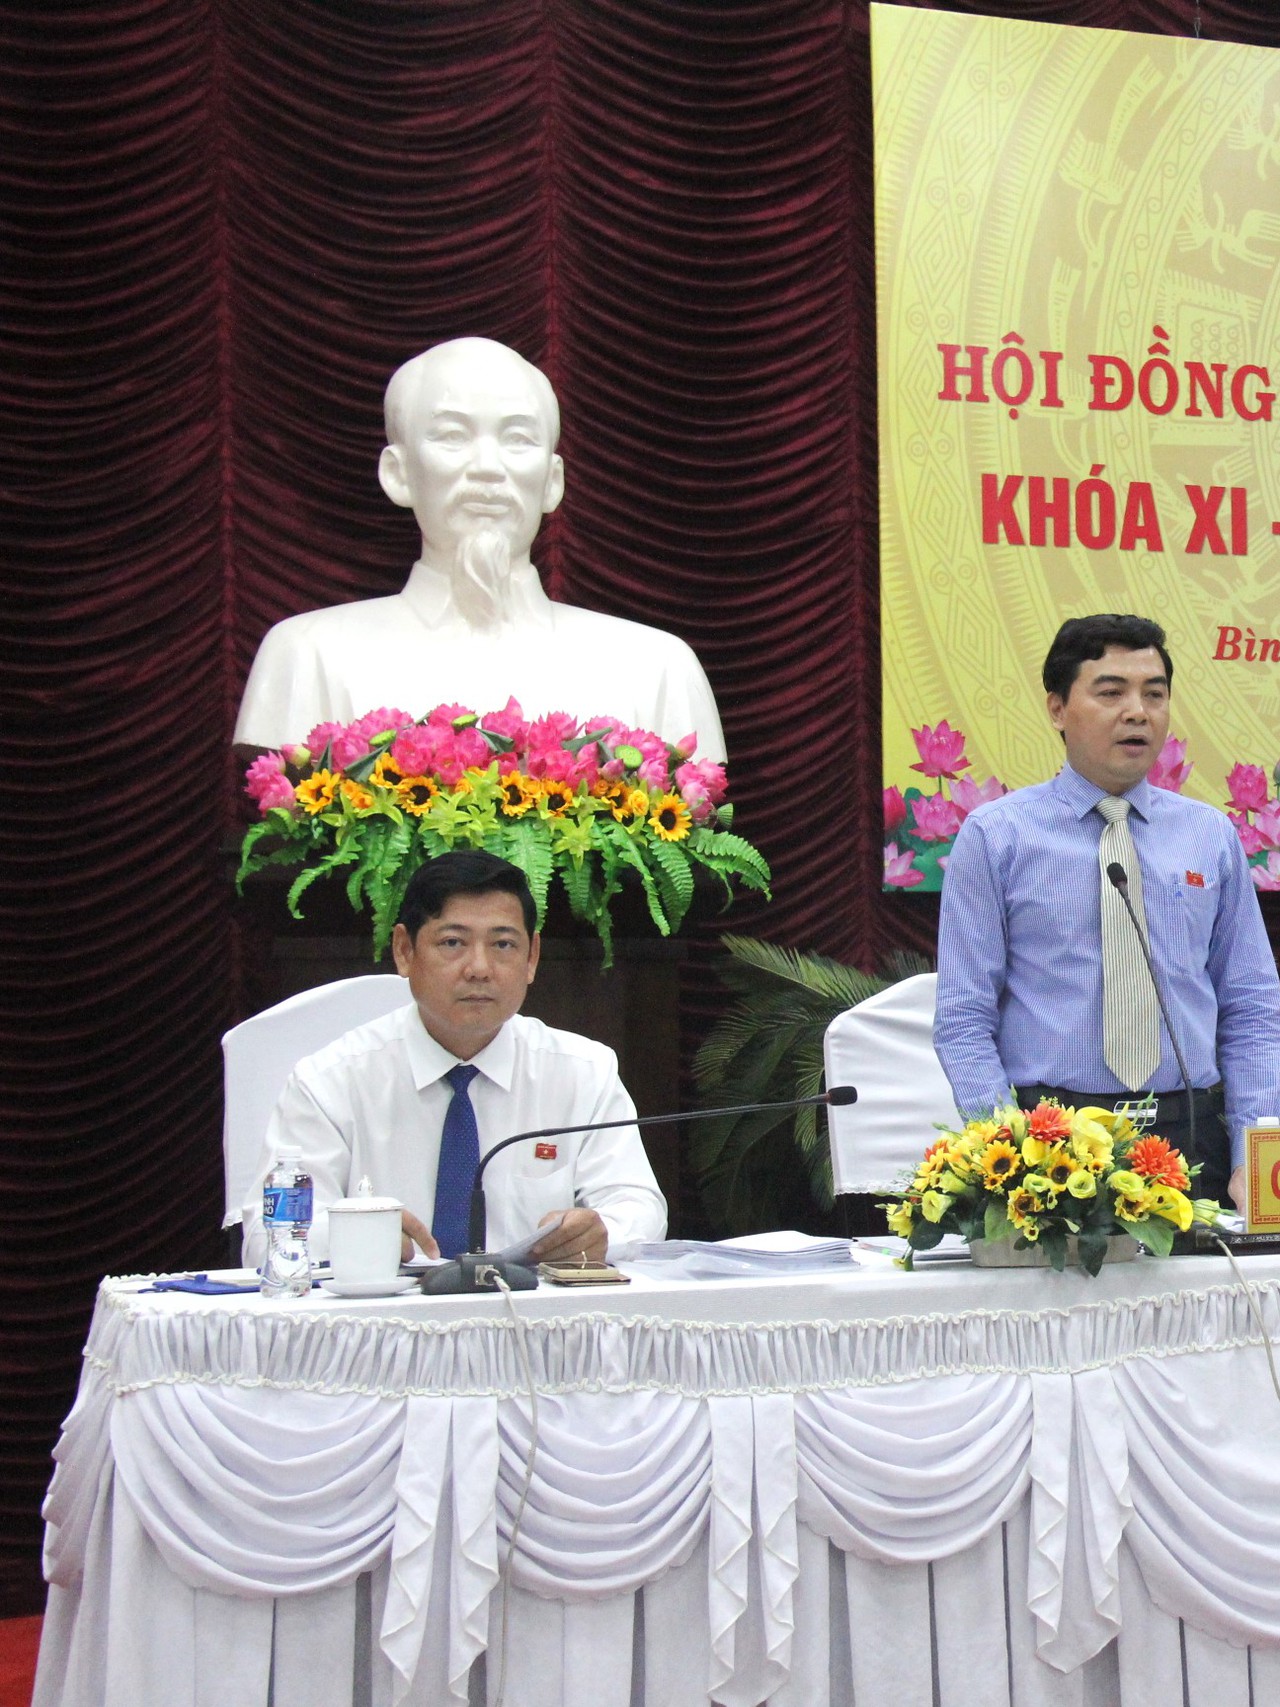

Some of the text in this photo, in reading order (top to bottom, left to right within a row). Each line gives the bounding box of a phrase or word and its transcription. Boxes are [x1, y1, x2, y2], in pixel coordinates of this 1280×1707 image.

[938, 331, 1063, 420] HỘI
[1088, 325, 1276, 421] ĐỒNG
[981, 464, 1164, 552] KHÓA
[1184, 484, 1249, 556] XI
